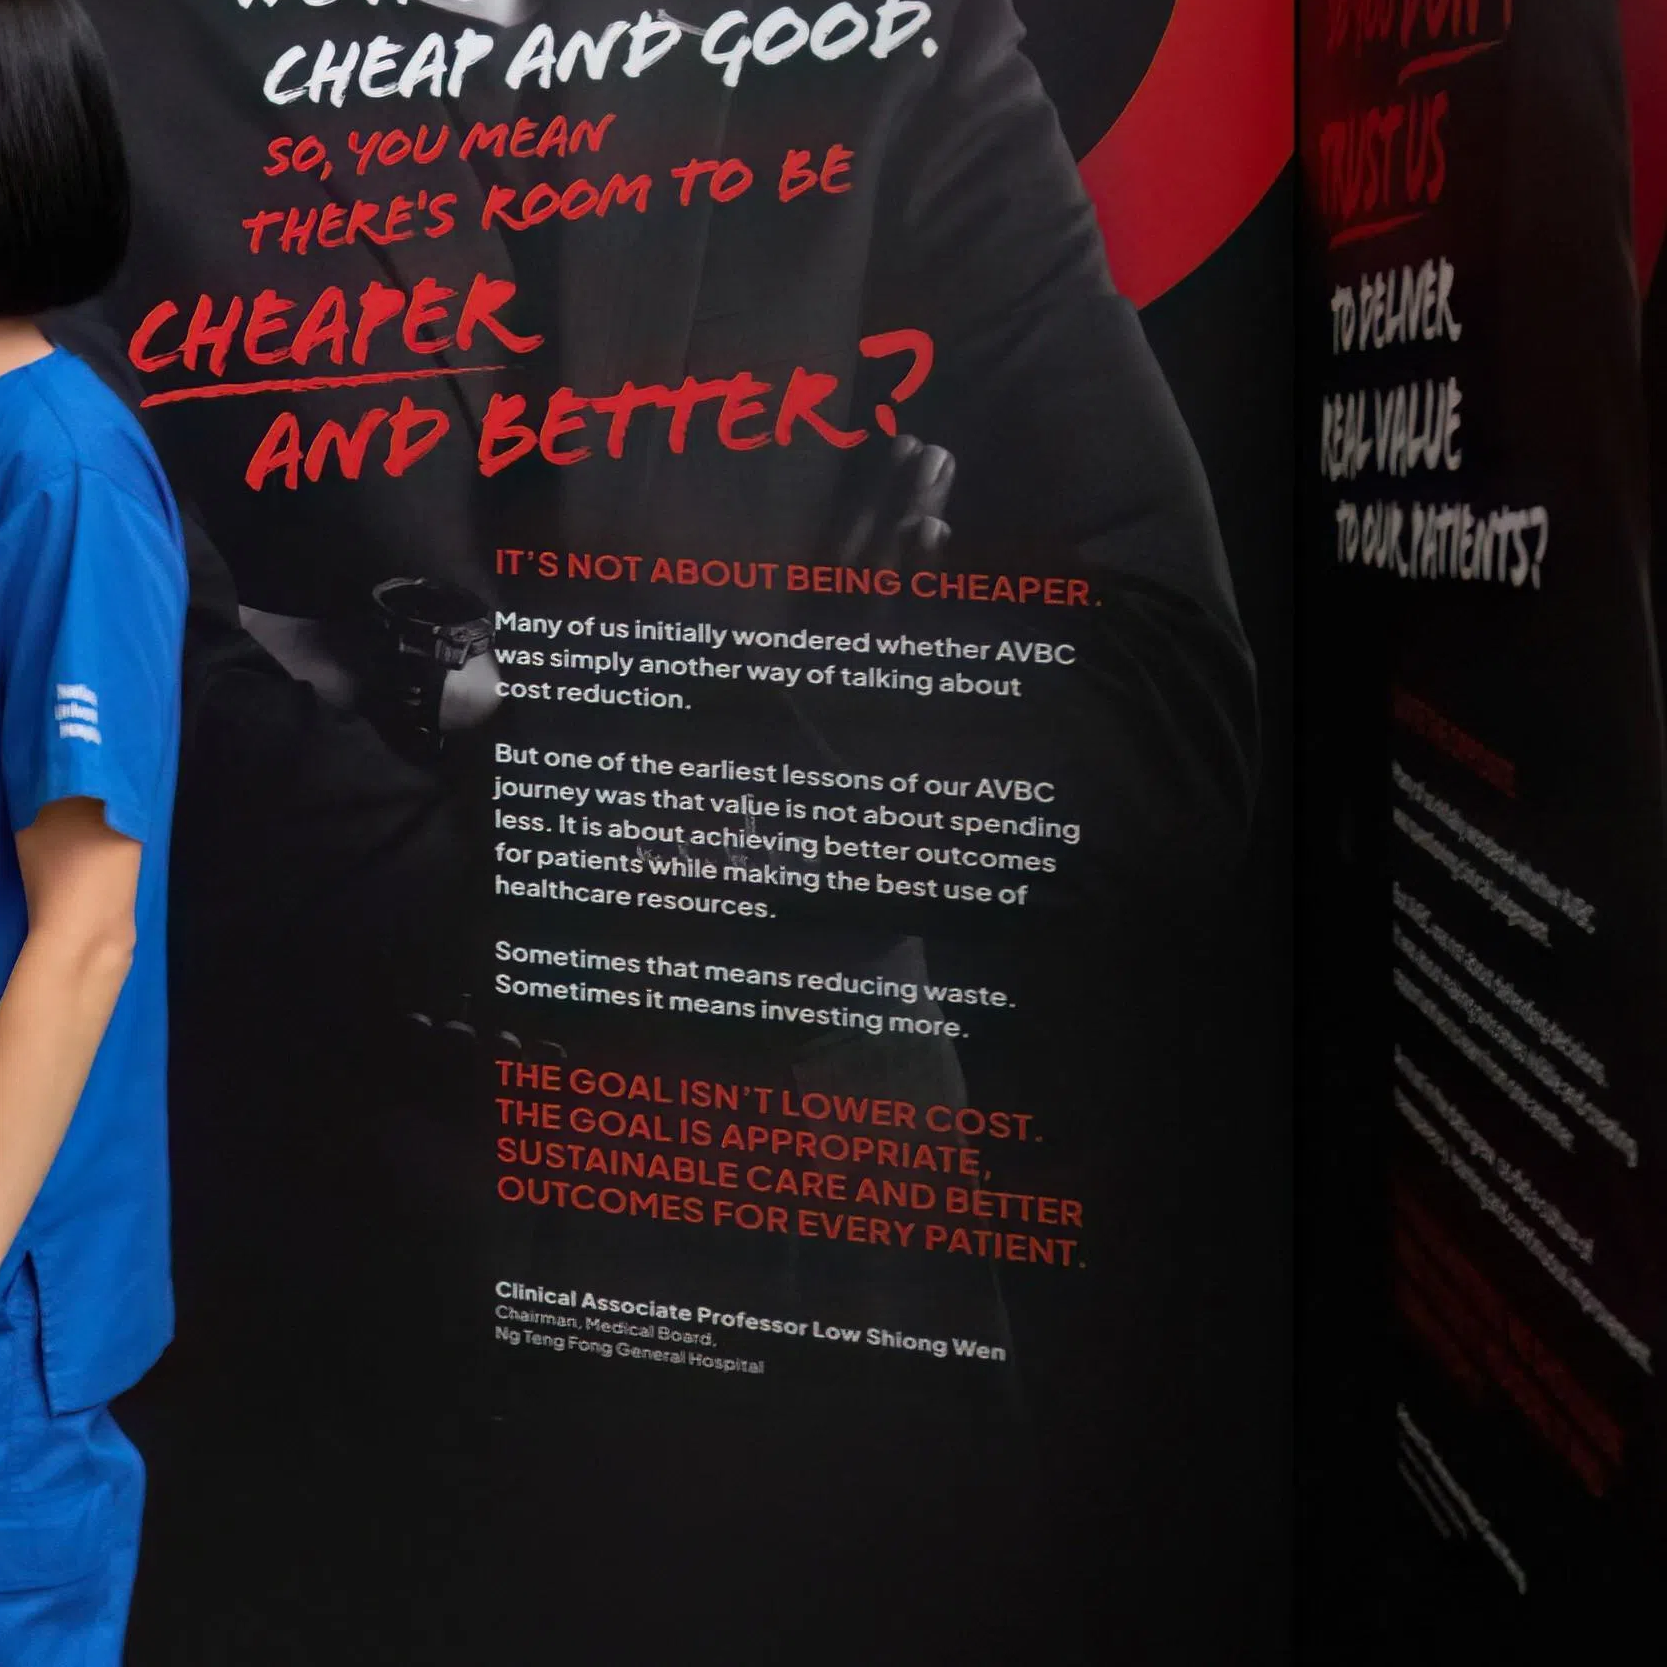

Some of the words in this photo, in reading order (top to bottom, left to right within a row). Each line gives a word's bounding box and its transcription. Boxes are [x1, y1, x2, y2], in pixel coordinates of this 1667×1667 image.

[262, 34, 494, 107] CHEAP
[505, 11, 679, 92] AND
[262, 132, 334, 182] SO,
[347, 123, 450, 177] YOU
[459, 112, 618, 163] MEAN
[1320, 102, 1403, 218] TRUST
[1406, 90, 1448, 205] US
[242, 189, 456, 256] THERE'S
[481, 175, 651, 233] ROOM
[672, 153, 751, 207] TO
[778, 144, 855, 200] BE
[128, 273, 544, 377] CHEAPER
[1332, 283, 1356, 355] TO
[1359, 256, 1462, 354] DELIVER
[245, 406, 451, 492] AND
[478, 329, 935, 478] BETTER?
[1320, 391, 1374, 481] REAL
[1375, 376, 1463, 478] VALUE
[497, 549, 558, 577] IT'S
[568, 553, 642, 582] NOT
[651, 558, 779, 589] ABOUT
[787, 564, 901, 596] BEING
[912, 571, 1102, 606] CHEAPER.
[1336, 499, 1361, 564] TO
[1362, 499, 1409, 579] OUR
[1410, 501, 1549, 591] PATIENTS?
[495, 611, 562, 638] Many
[568, 617, 595, 636] of
[601, 623, 629, 638] us
[635, 620, 727, 649] initially
[732, 629, 870, 652] wondered
[876, 635, 990, 659] whether
[996, 641, 1074, 664] AVBC
[495, 649, 544, 666] was
[550, 649, 633, 676] simply
[639, 657, 742, 678] another
[747, 666, 801, 687] way
[807, 665, 835, 684] of
[841, 668, 932, 695] talking
[939, 673, 1021, 696] about
[495, 678, 551, 699] cost
[557, 684, 691, 709] reduction.
[496, 743, 539, 765] But
[544, 752, 592, 769] one
[598, 752, 625, 771] of
[631, 754, 673, 775] the
[679, 760, 776, 782] earliest
[783, 764, 883, 790] lessons
[890, 773, 918, 792] of
[925, 780, 970, 796] our
[975, 779, 1054, 802] AVBC
[492, 777, 590, 806] journey
[595, 789, 646, 806] was
[652, 790, 704, 811] that
[710, 794, 779, 816] value
[786, 799, 806, 819] is
[813, 806, 857, 823] not
[864, 806, 944, 829] about
[951, 816, 1079, 844] spending
[496, 809, 551, 832] less.
[560, 814, 576, 834] It
[583, 817, 602, 836] is
[608, 820, 685, 843] about
[690, 827, 818, 858] achieving
[825, 835, 910, 860] better
[916, 848, 1055, 872] outcomes
[495, 842, 532, 863] for
[537, 850, 645, 873] patients
[649, 854, 717, 879] while
[724, 862, 819, 891] making
[826, 870, 870, 891] the
[877, 874, 937, 897] best
[944, 884, 991, 901] use
[999, 885, 1028, 904] of
[496, 875, 631, 905] healthcare
[637, 893, 775, 918] resources.
[496, 941, 640, 973] Sometimes
[646, 956, 699, 979] that
[705, 966, 791, 987] means
[798, 972, 917, 1004] reducing
[924, 986, 1015, 1007] waste.
[496, 974, 640, 1006] Sometimes
[647, 989, 663, 1009] it
[669, 996, 755, 1017] means
[762, 1000, 882, 1035] investing
[889, 1017, 968, 1037] more.
[496, 1060, 561, 1090] THE
[569, 1069, 671, 1103] GOAL
[680, 1079, 772, 1114] ISN'T
[782, 1090, 916, 1128] LOWER
[927, 1106, 1042, 1142] COST.
[496, 1098, 560, 1129] THE
[570, 1107, 671, 1142] GOAL
[681, 1118, 712, 1146] IS
[722, 1124, 989, 1180] APPROPRIATE,
[497, 1137, 737, 1188] SUSTAINABLE
[747, 1166, 846, 1200] CARE
[856, 1178, 935, 1209] AND
[947, 1187, 1081, 1224] BETTER
[498, 1176, 703, 1222] OUTCOMES
[714, 1200, 788, 1232] FOR
[798, 1210, 913, 1246] EVERY
[926, 1225, 1086, 1268] PATIENT.
[496, 1281, 576, 1307] Clinical
[582, 1293, 692, 1321] Associate
[698, 1307, 808, 1335] Professor
[813, 1321, 861, 1342] Low
[867, 1328, 947, 1357] Shiong
[952, 1338, 1005, 1360] Wen
[496, 1326, 520, 1345] Ng
[523, 1330, 565, 1351] Teng
[568, 1336, 612, 1357] Fong
[616, 1342, 685, 1363] General
[689, 1352, 763, 1373] Hospital
[586, 1317, 654, 1337] Medical
